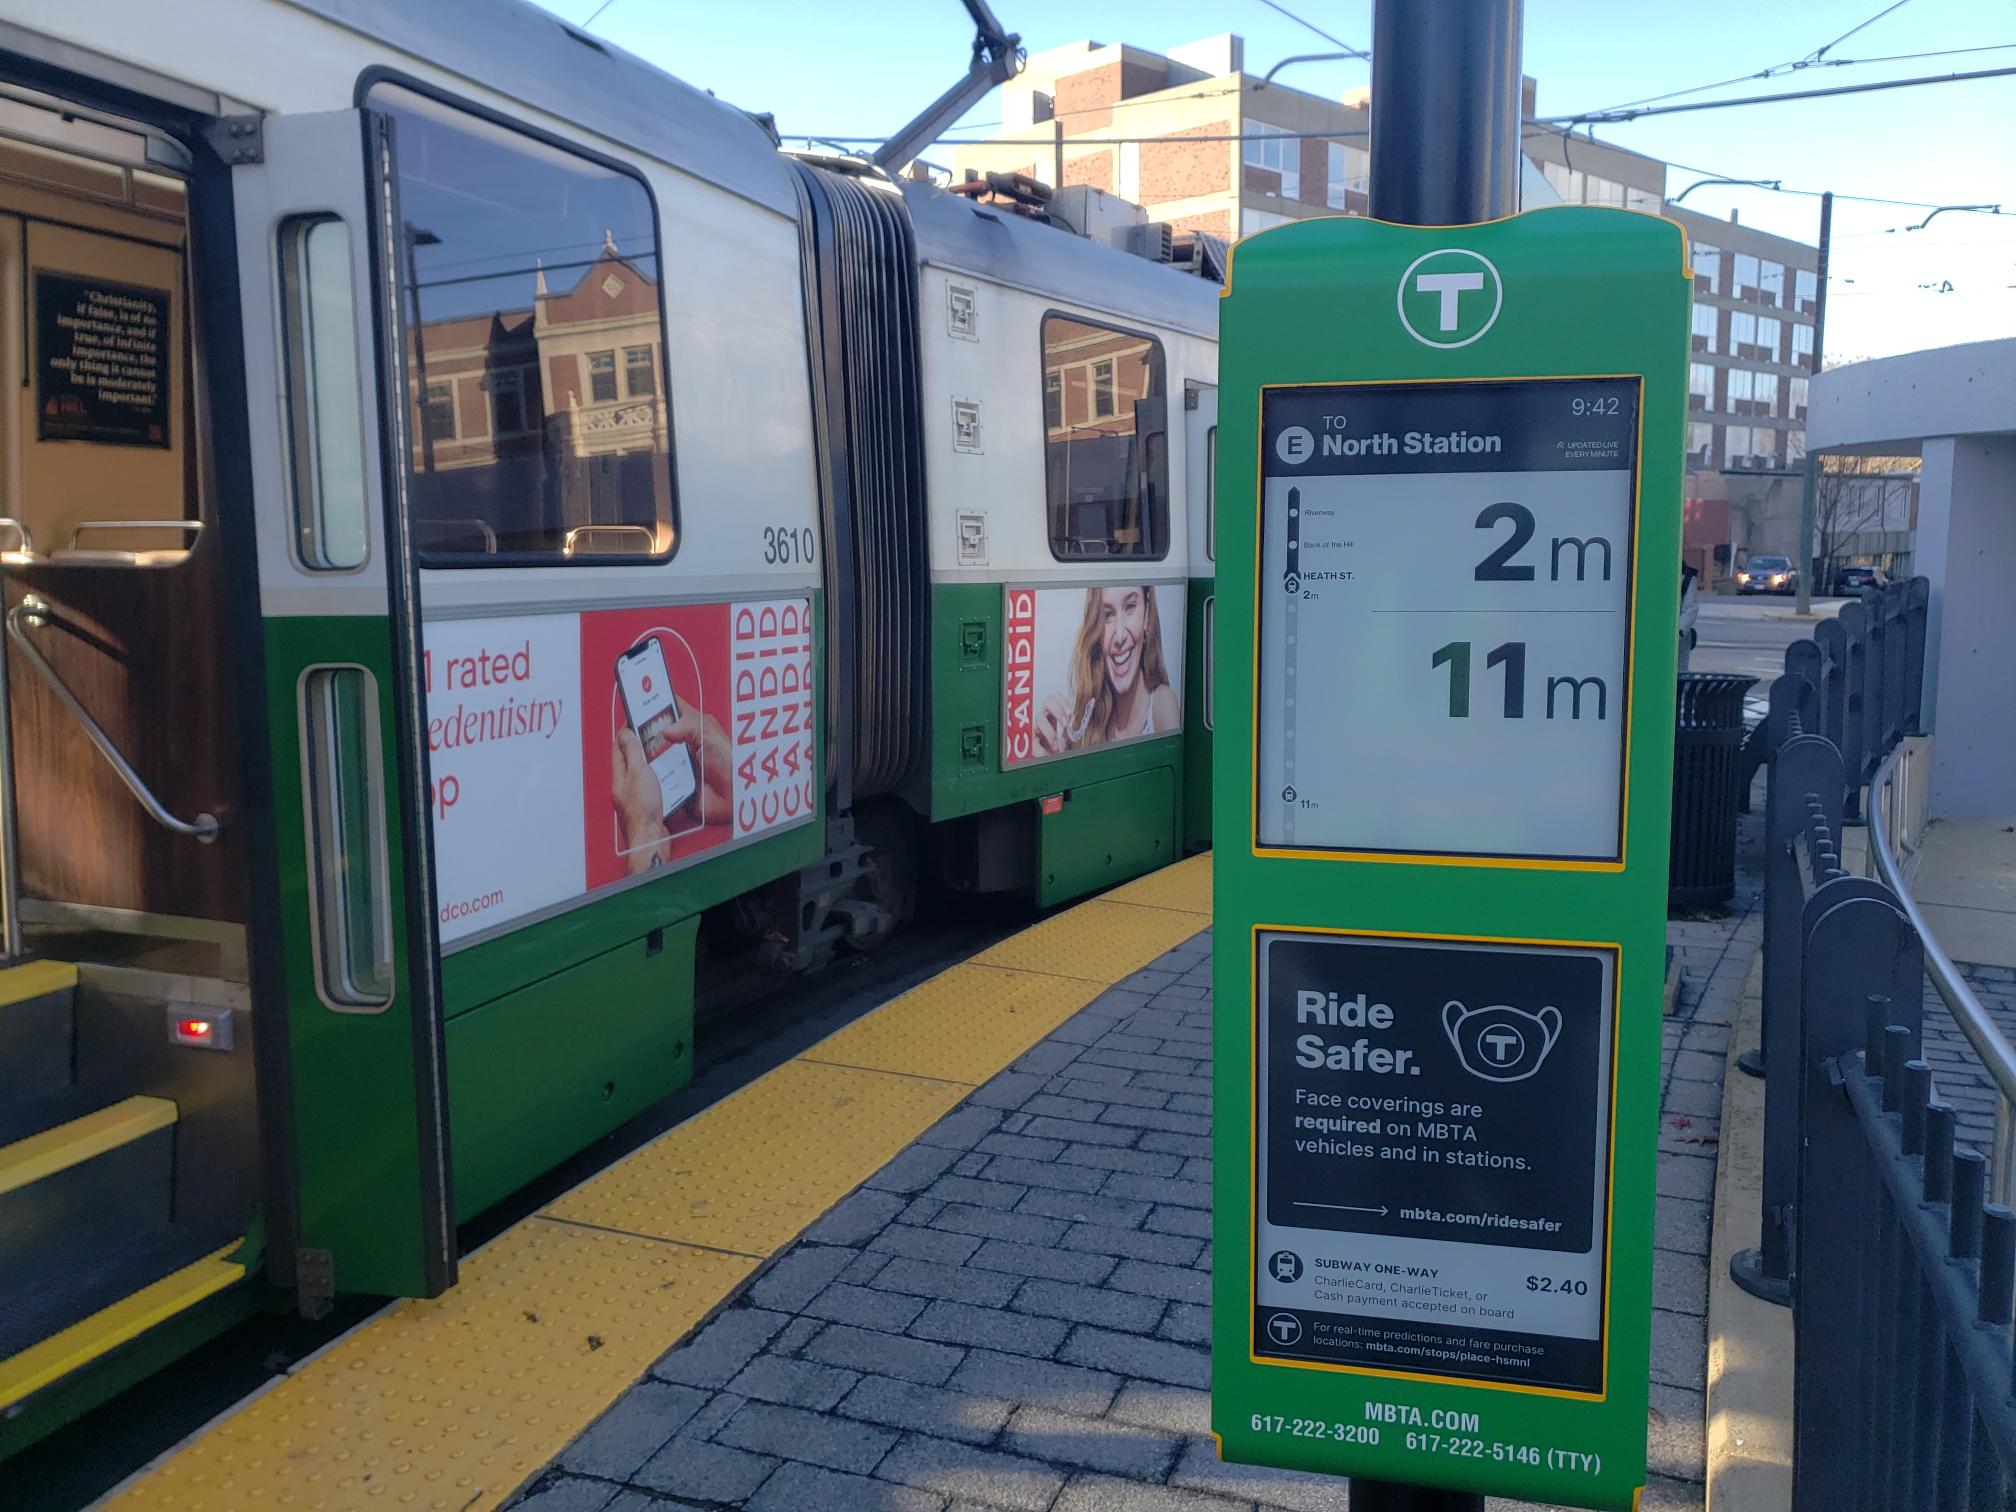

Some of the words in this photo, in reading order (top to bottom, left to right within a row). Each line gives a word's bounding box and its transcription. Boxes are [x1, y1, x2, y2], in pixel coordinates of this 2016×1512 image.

[1417, 272, 1484, 331] T
[1572, 397, 1619, 416] 9:42
[1322, 415, 1347, 430] TO
[1287, 435, 1303, 455] E
[1322, 432, 1398, 456] North
[1403, 430, 1502, 455] Station
[1565, 450, 1590, 458] EVERY
[1590, 449, 1619, 457] MINUTE
[1567, 441, 1602, 449] UPDATED
[764, 526, 815, 564] 3610
[1303, 572, 1338, 580] HEATH
[1339, 571, 1356, 580] ST.
[1303, 590, 1319, 600] 2m
[447, 639, 530, 690] rated
[1013, 593, 1032, 759] CANDID
[736, 607, 758, 832] CANDID
[759, 606, 780, 825] CANDID
[781, 605, 801, 817] CANDID
[431, 775, 460, 820] p
[1296, 989, 1395, 1030] Ride
[1295, 1033, 1421, 1076] Safer.
[1485, 1034, 1517, 1061] T
[1295, 1088, 1342, 1108] Face
[1347, 1093, 1445, 1118] coverings
[1450, 1102, 1483, 1119] are
[1295, 1113, 1381, 1134] required
[1386, 1121, 1412, 1137] on
[1417, 1121, 1478, 1142] MBTA
[1294, 1138, 1375, 1159] vehicles
[1380, 1145, 1417, 1162] and
[1422, 1146, 1440, 1163] in
[1446, 1150, 1533, 1172] stations.
[1399, 1206, 1563, 1233] mbta.com/ridesafer
[1314, 1257, 1372, 1273] SUBWAY
[1374, 1262, 1440, 1279] ONE-WAY
[1314, 1275, 1387, 1294] CharlieCard,
[1390, 1282, 1472, 1302] CharlieTicket,
[1475, 1292, 1489, 1302] or
[1526, 1274, 1588, 1296] $2.40
[1314, 1289, 1344, 1302] Cash
[1347, 1294, 1399, 1308] payment
[1401, 1299, 1457, 1313] accepted
[1460, 1306, 1476, 1316] on
[1479, 1306, 1515, 1319] board
[1273, 1320, 1297, 1340] T
[1313, 1321, 1331, 1333] For
[1333, 1324, 1381, 1339] real-time
[1383, 1329, 1443, 1345] predictions
[1445, 1337, 1466, 1348] and
[1469, 1338, 1491, 1350] fare
[1493, 1341, 1545, 1355] purchase
[1313, 1335, 1363, 1349] locations:
[1365, 1401, 1480, 1433] MBTA.COM
[1251, 1414, 1380, 1445] 617-222-3200
[1406, 1432, 1541, 1466] 617-222-5146
[1547, 1448, 1602, 1477] (TTY)
